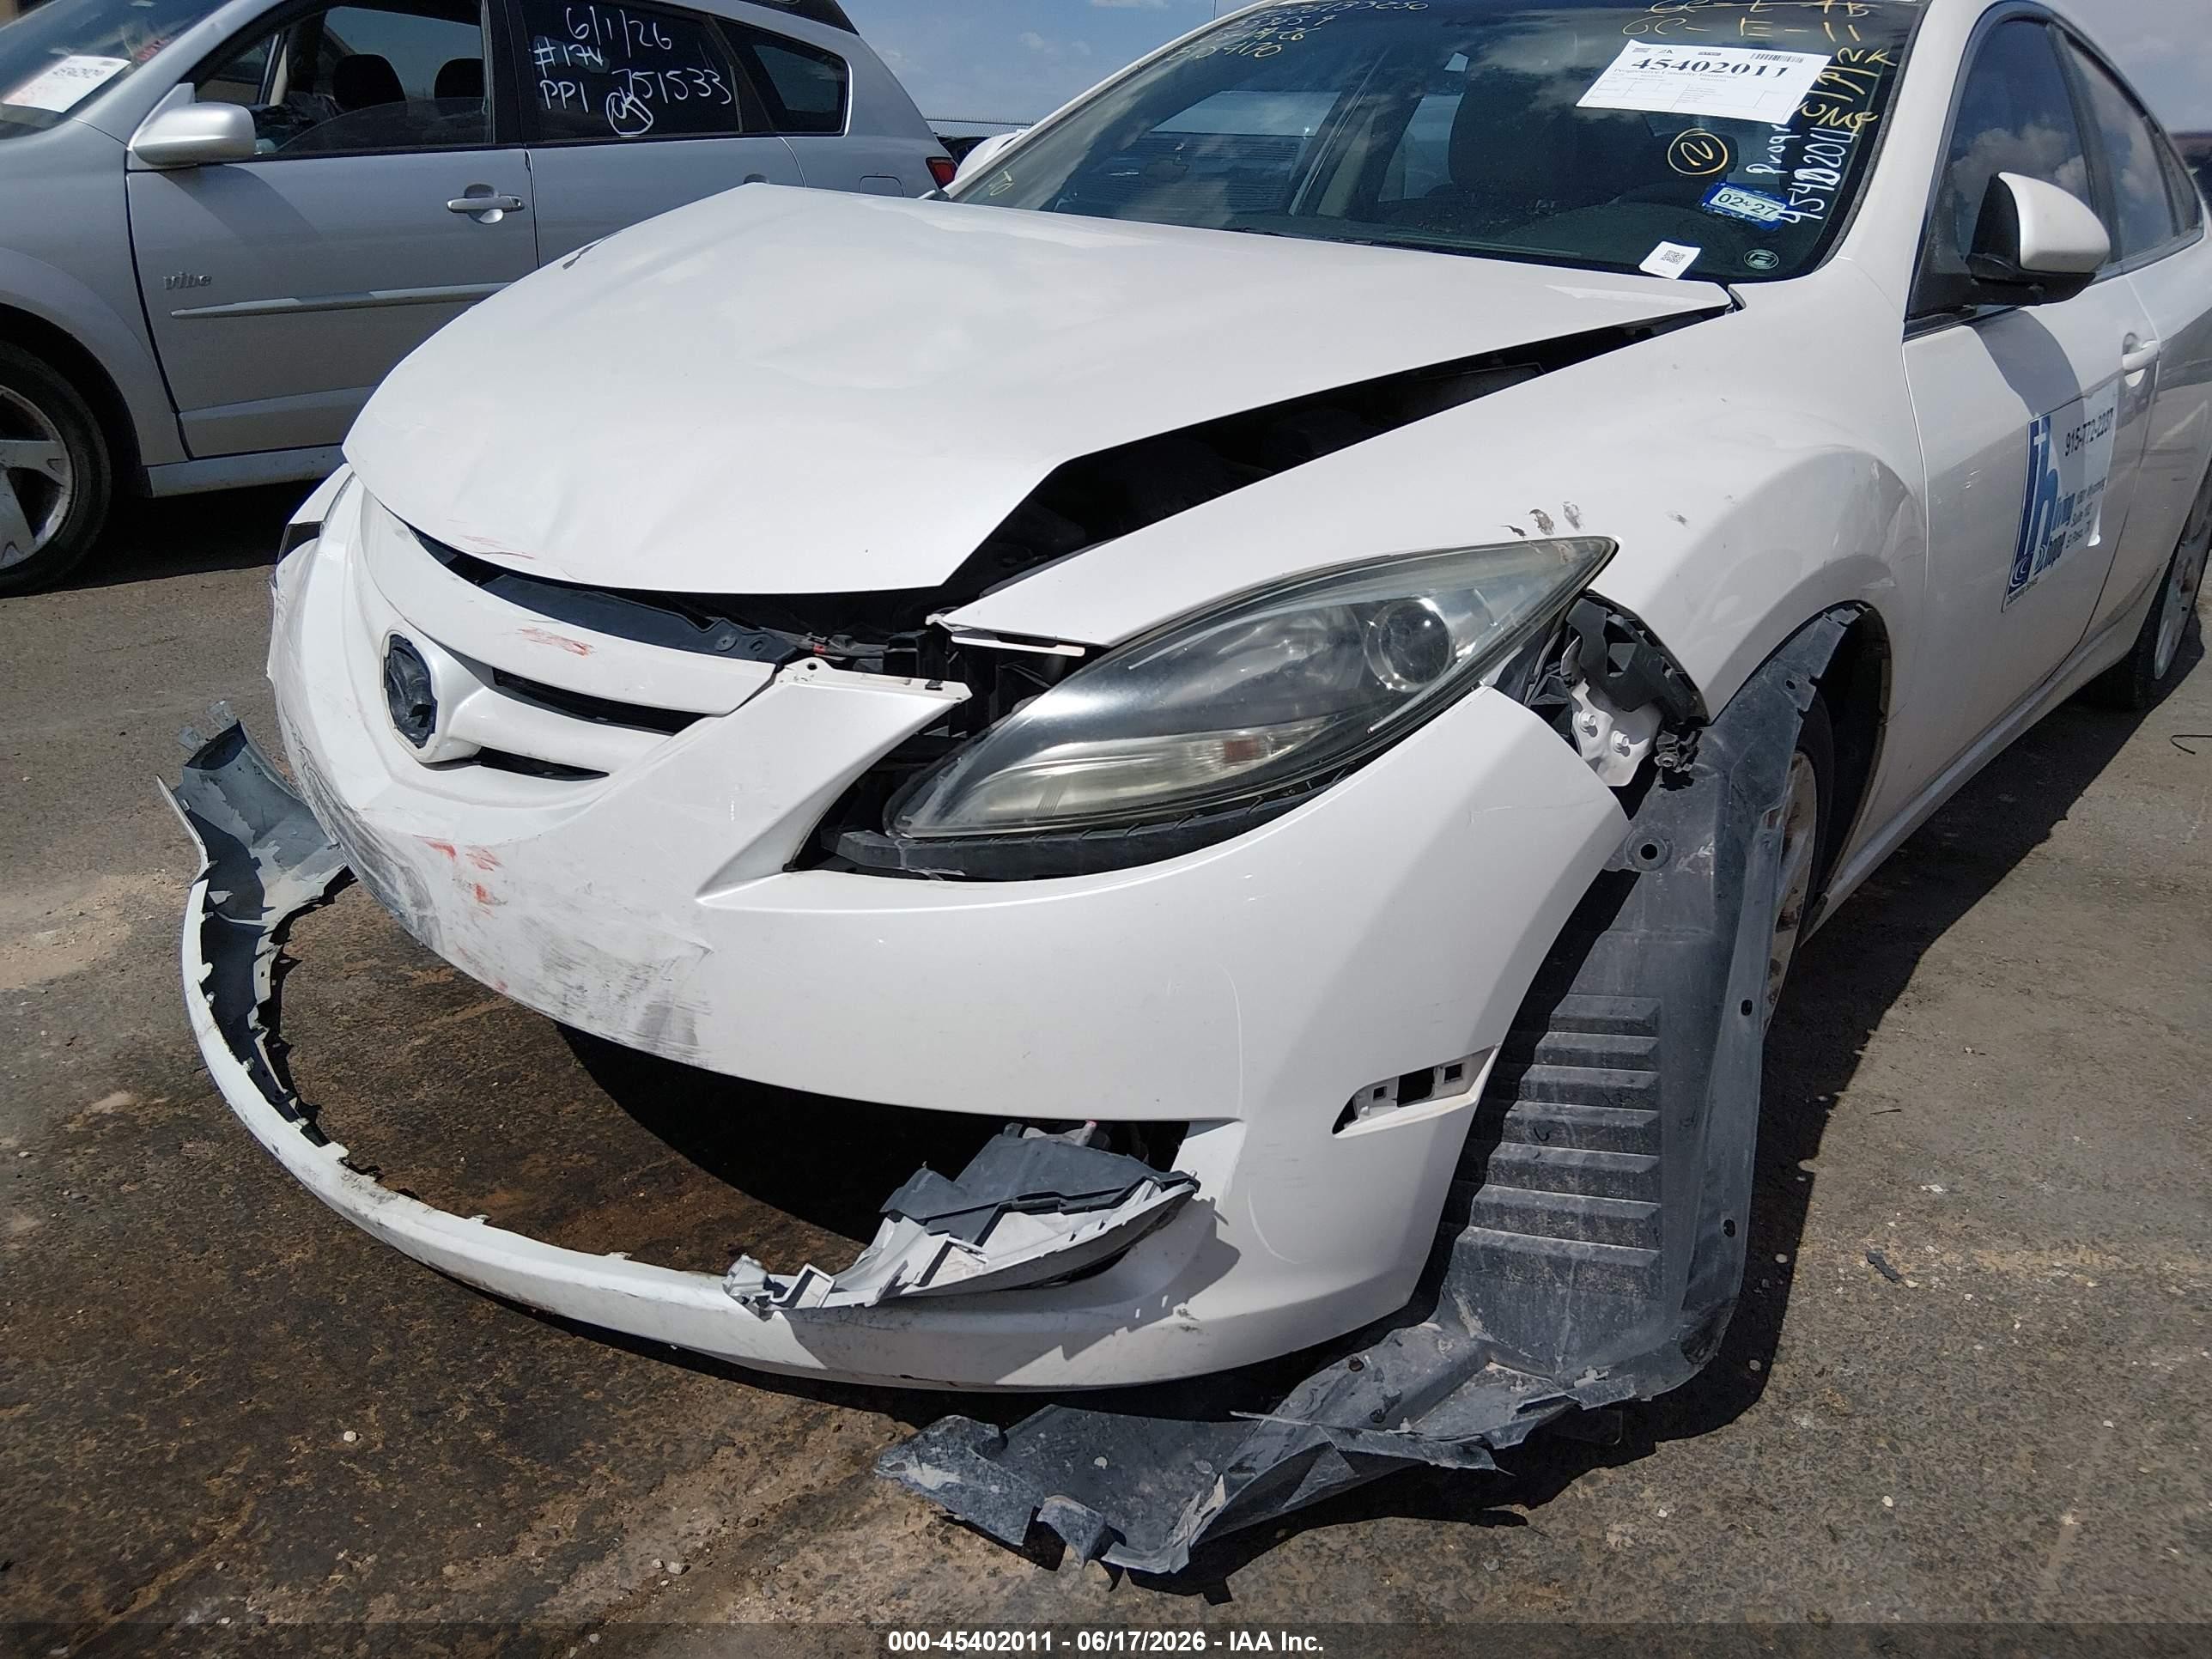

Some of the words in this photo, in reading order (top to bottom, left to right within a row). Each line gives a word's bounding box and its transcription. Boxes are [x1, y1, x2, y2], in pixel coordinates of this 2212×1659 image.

[566, 5, 672, 58] 6/1/26
[1632, 57, 1788, 78] 45402011
[611, 67, 731, 105] 751533
[1718, 193, 1743, 207] 02
[1749, 203, 1778, 216] 27
